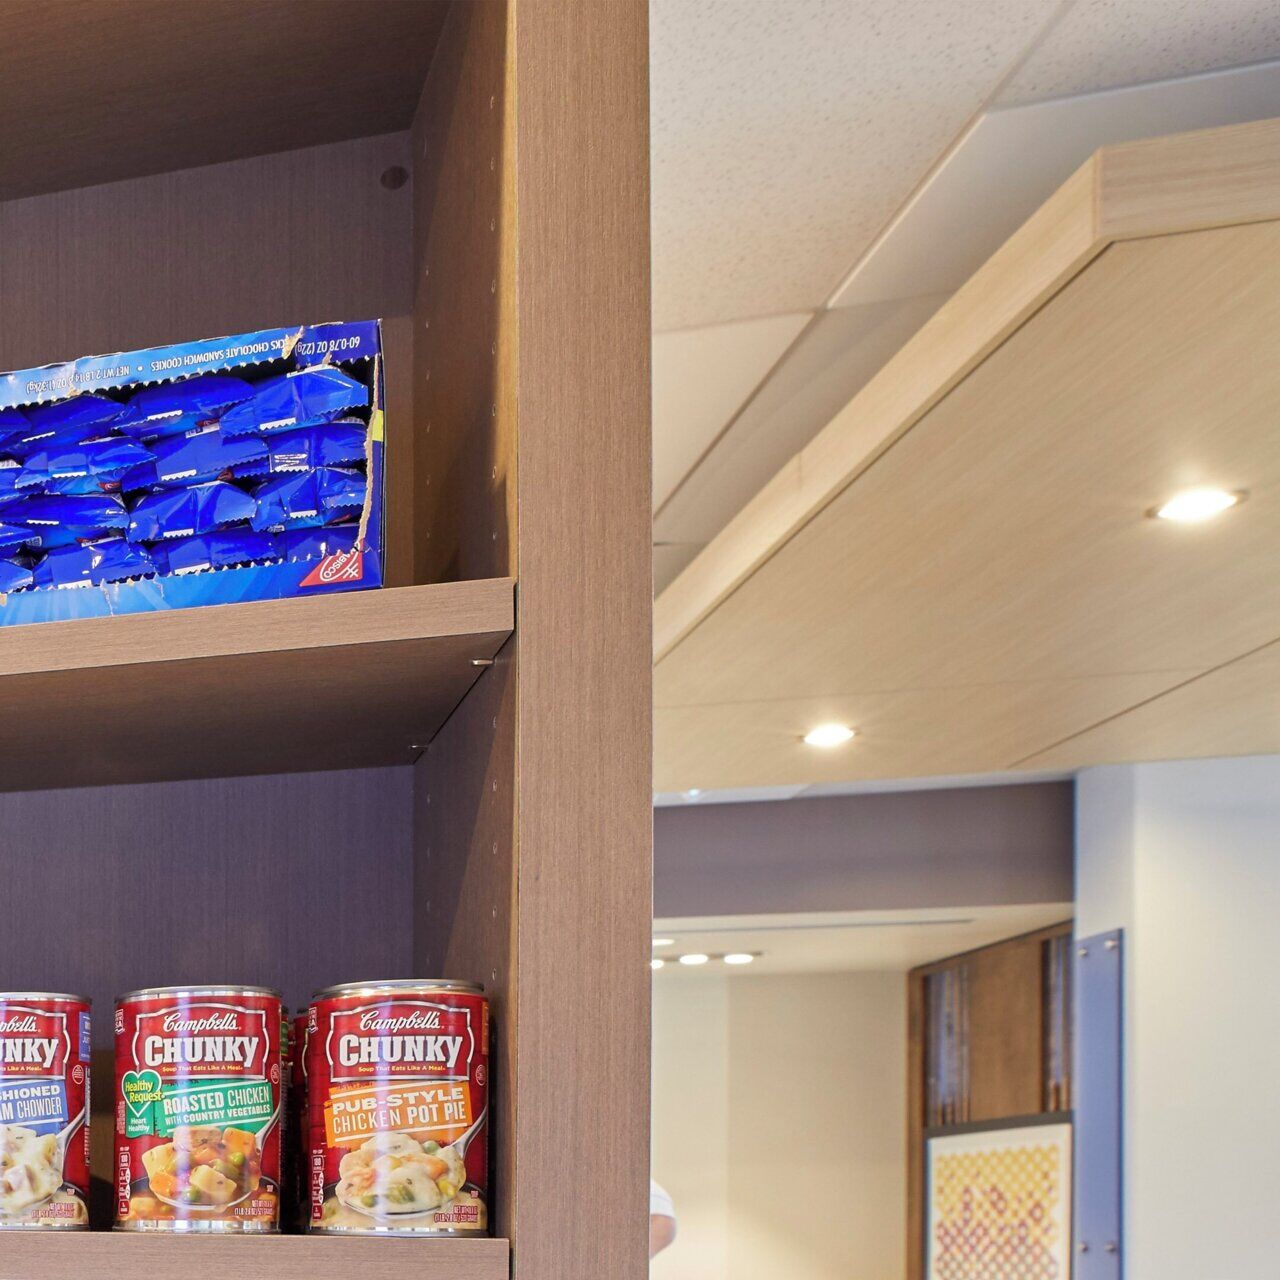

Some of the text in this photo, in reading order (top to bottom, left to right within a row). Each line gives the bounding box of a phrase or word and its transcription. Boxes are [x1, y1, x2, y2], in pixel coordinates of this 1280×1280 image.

[226, 343, 269, 356] CHOCOLATE
[316, 341, 327, 353] OZ
[151, 357, 182, 370] COOKIES
[184, 349, 223, 365] SANDWICH
[117, 365, 130, 377] NET
[324, 551, 352, 578] ABISCO
[163, 1015, 238, 1034] Campbell's
[360, 1010, 441, 1031] Campbell's
[144, 1035, 259, 1066] CHUNKY
[339, 1035, 463, 1066] CHUNKY
[125, 1080, 154, 1094] Healthy
[129, 1090, 162, 1104] Request
[164, 1085, 270, 1116] ROASTED CHICKEN
[332, 1087, 464, 1115] PUB-STYLE
[17, 1097, 63, 1118] CHOWDER
[165, 1103, 271, 1125] WITH COUNTRY VEGETABLES
[129, 1116, 147, 1125] Heart
[332, 1101, 466, 1134] CHICKEN POT PIE
[128, 1123, 150, 1133] Healthy
